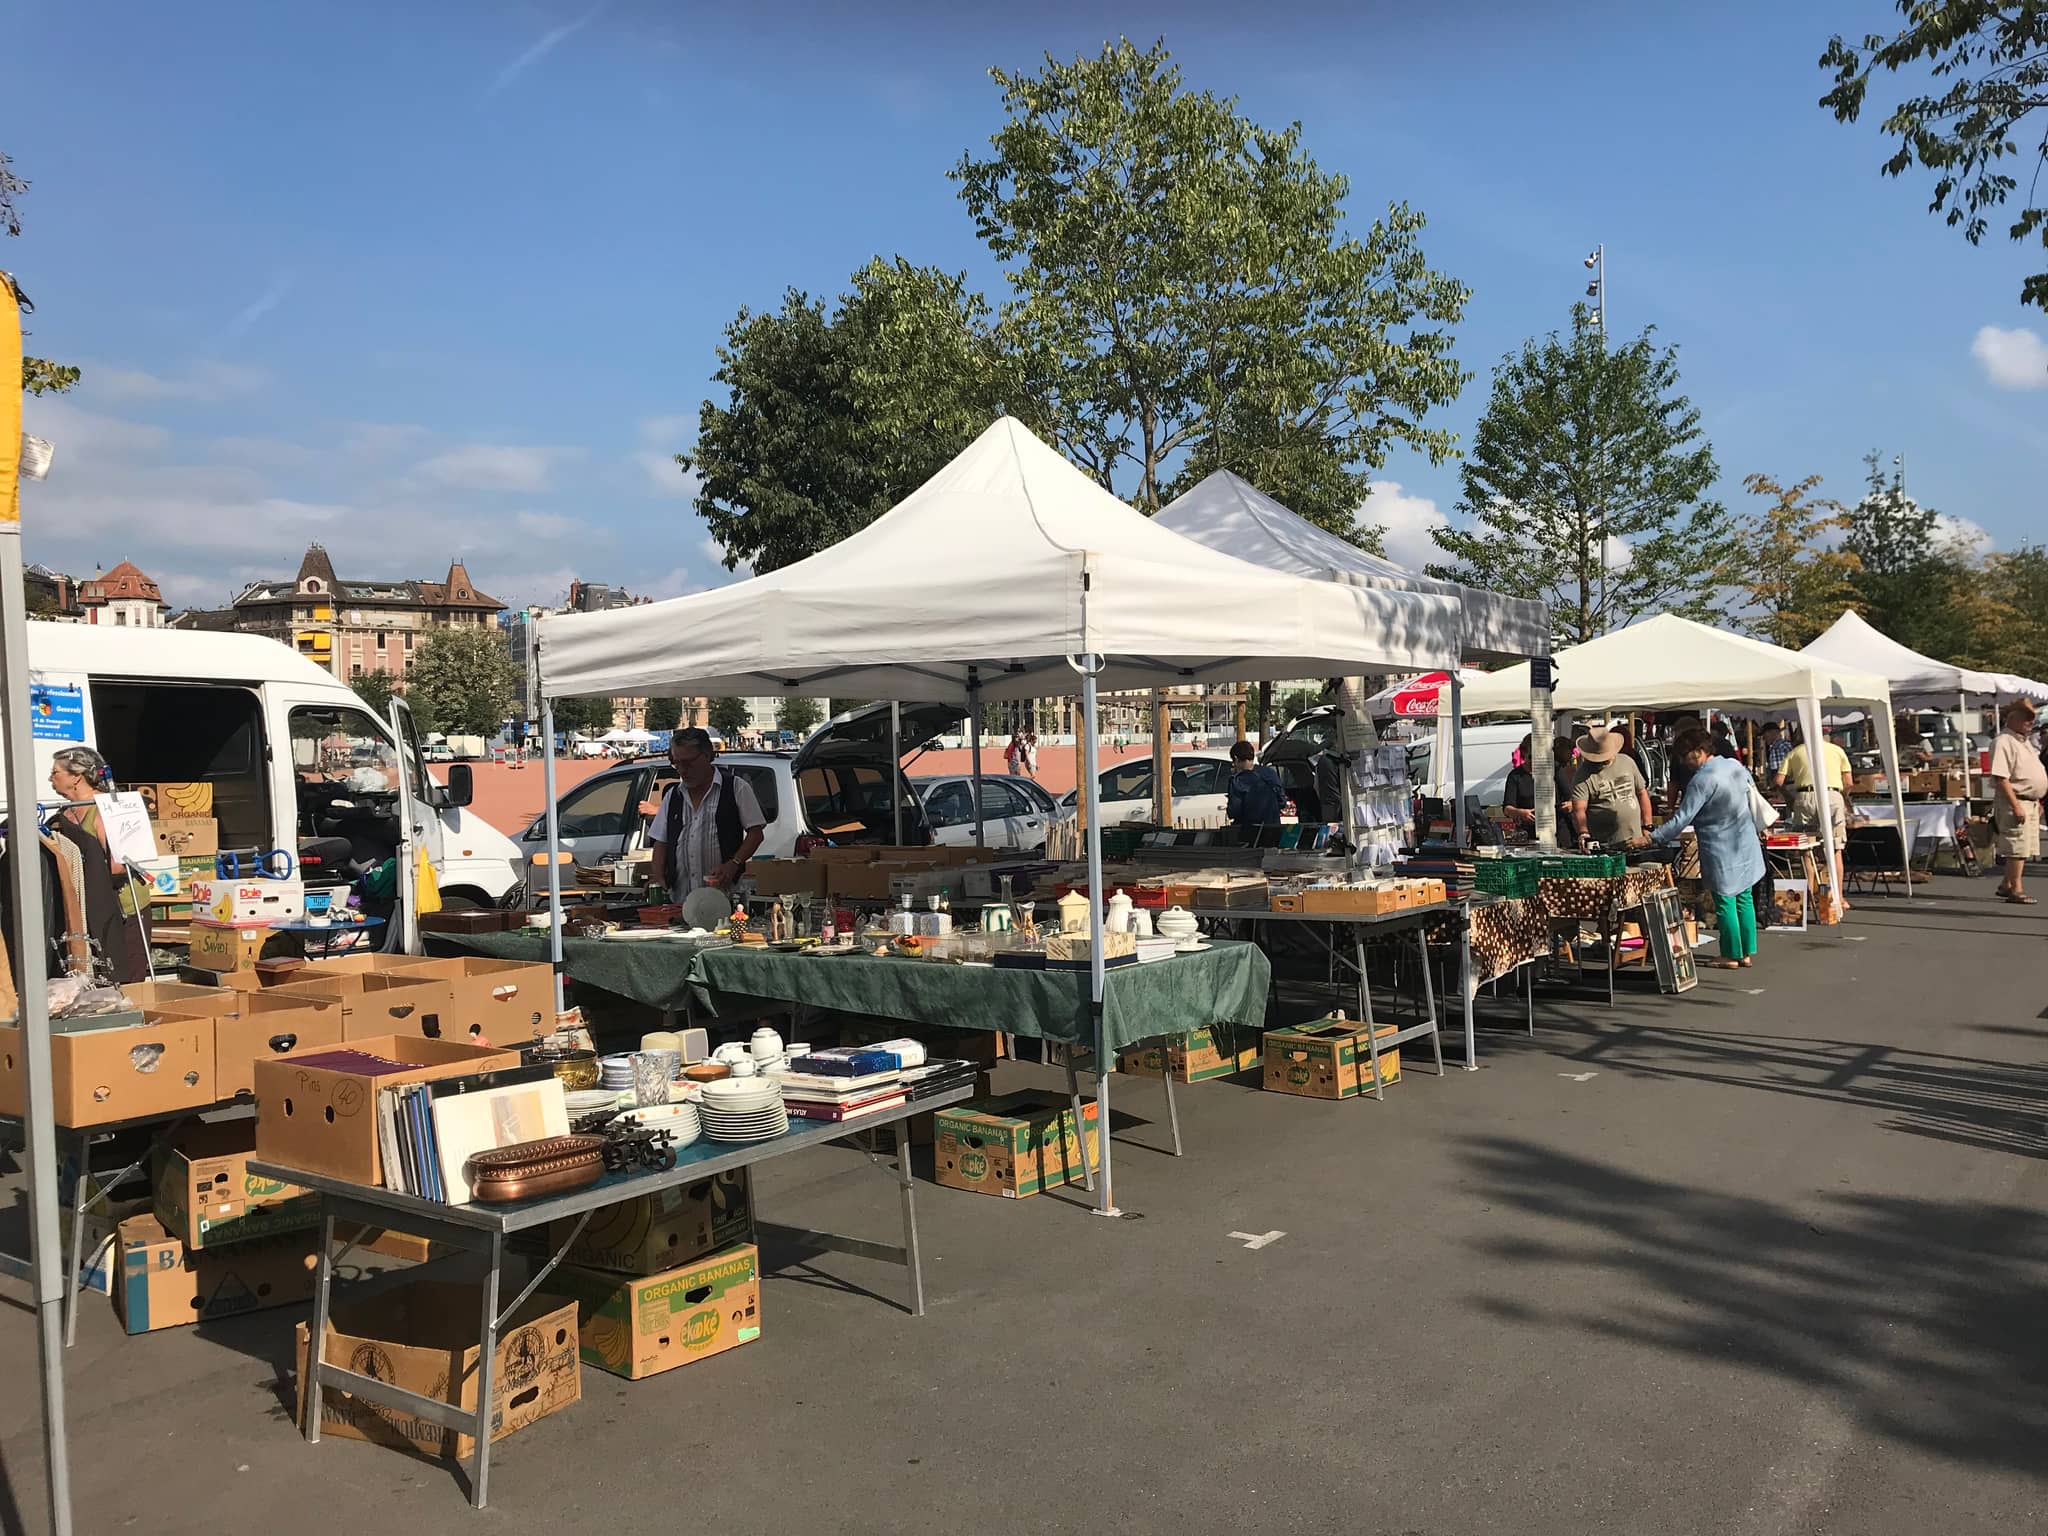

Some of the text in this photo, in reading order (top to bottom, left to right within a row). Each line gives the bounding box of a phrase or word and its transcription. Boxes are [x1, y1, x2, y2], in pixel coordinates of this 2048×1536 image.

[192, 883, 212, 901] Dole
[240, 888, 262, 898] Dole
[938, 1118, 1008, 1139] ORGANIC BANANAS
[644, 1258, 751, 1301] ORGANIC BANANAS
